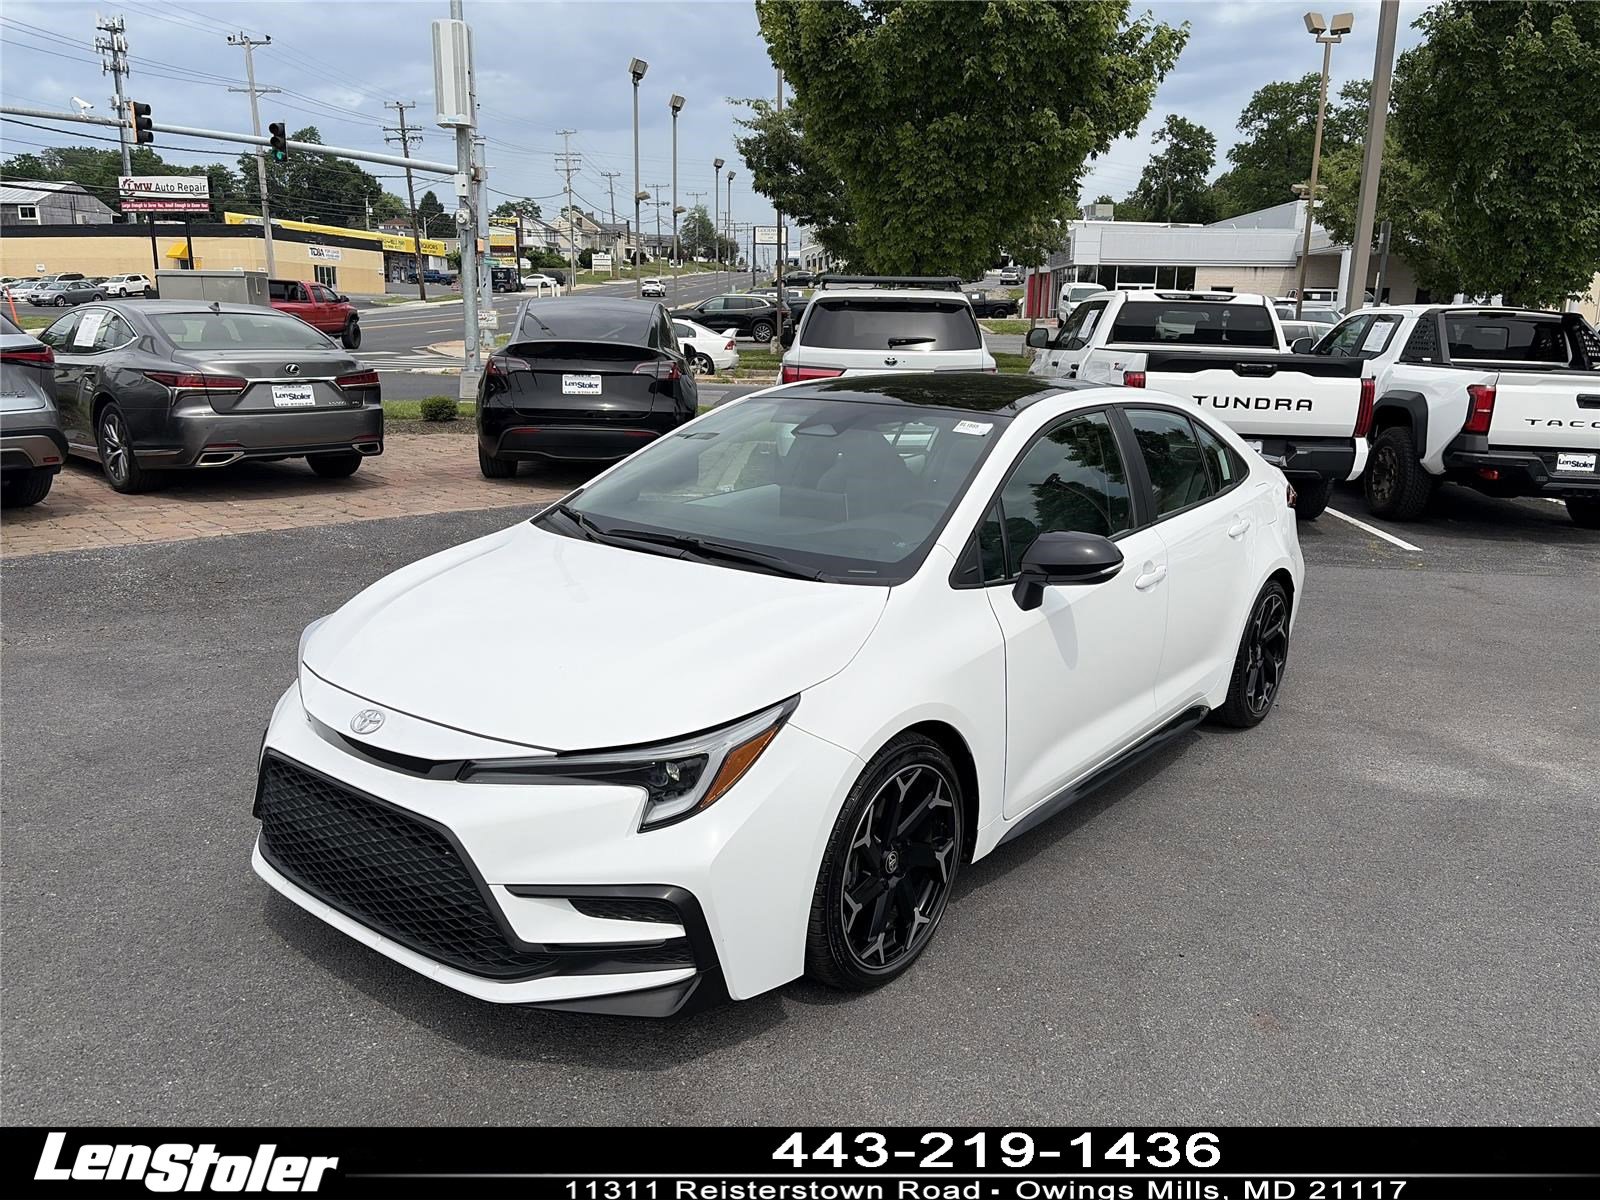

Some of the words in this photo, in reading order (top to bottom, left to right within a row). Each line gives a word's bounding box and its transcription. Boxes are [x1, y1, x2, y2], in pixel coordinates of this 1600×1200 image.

[155, 183, 175, 192] Auto
[177, 182, 207, 194] Repair
[1192, 395, 1313, 411] TUNDRA
